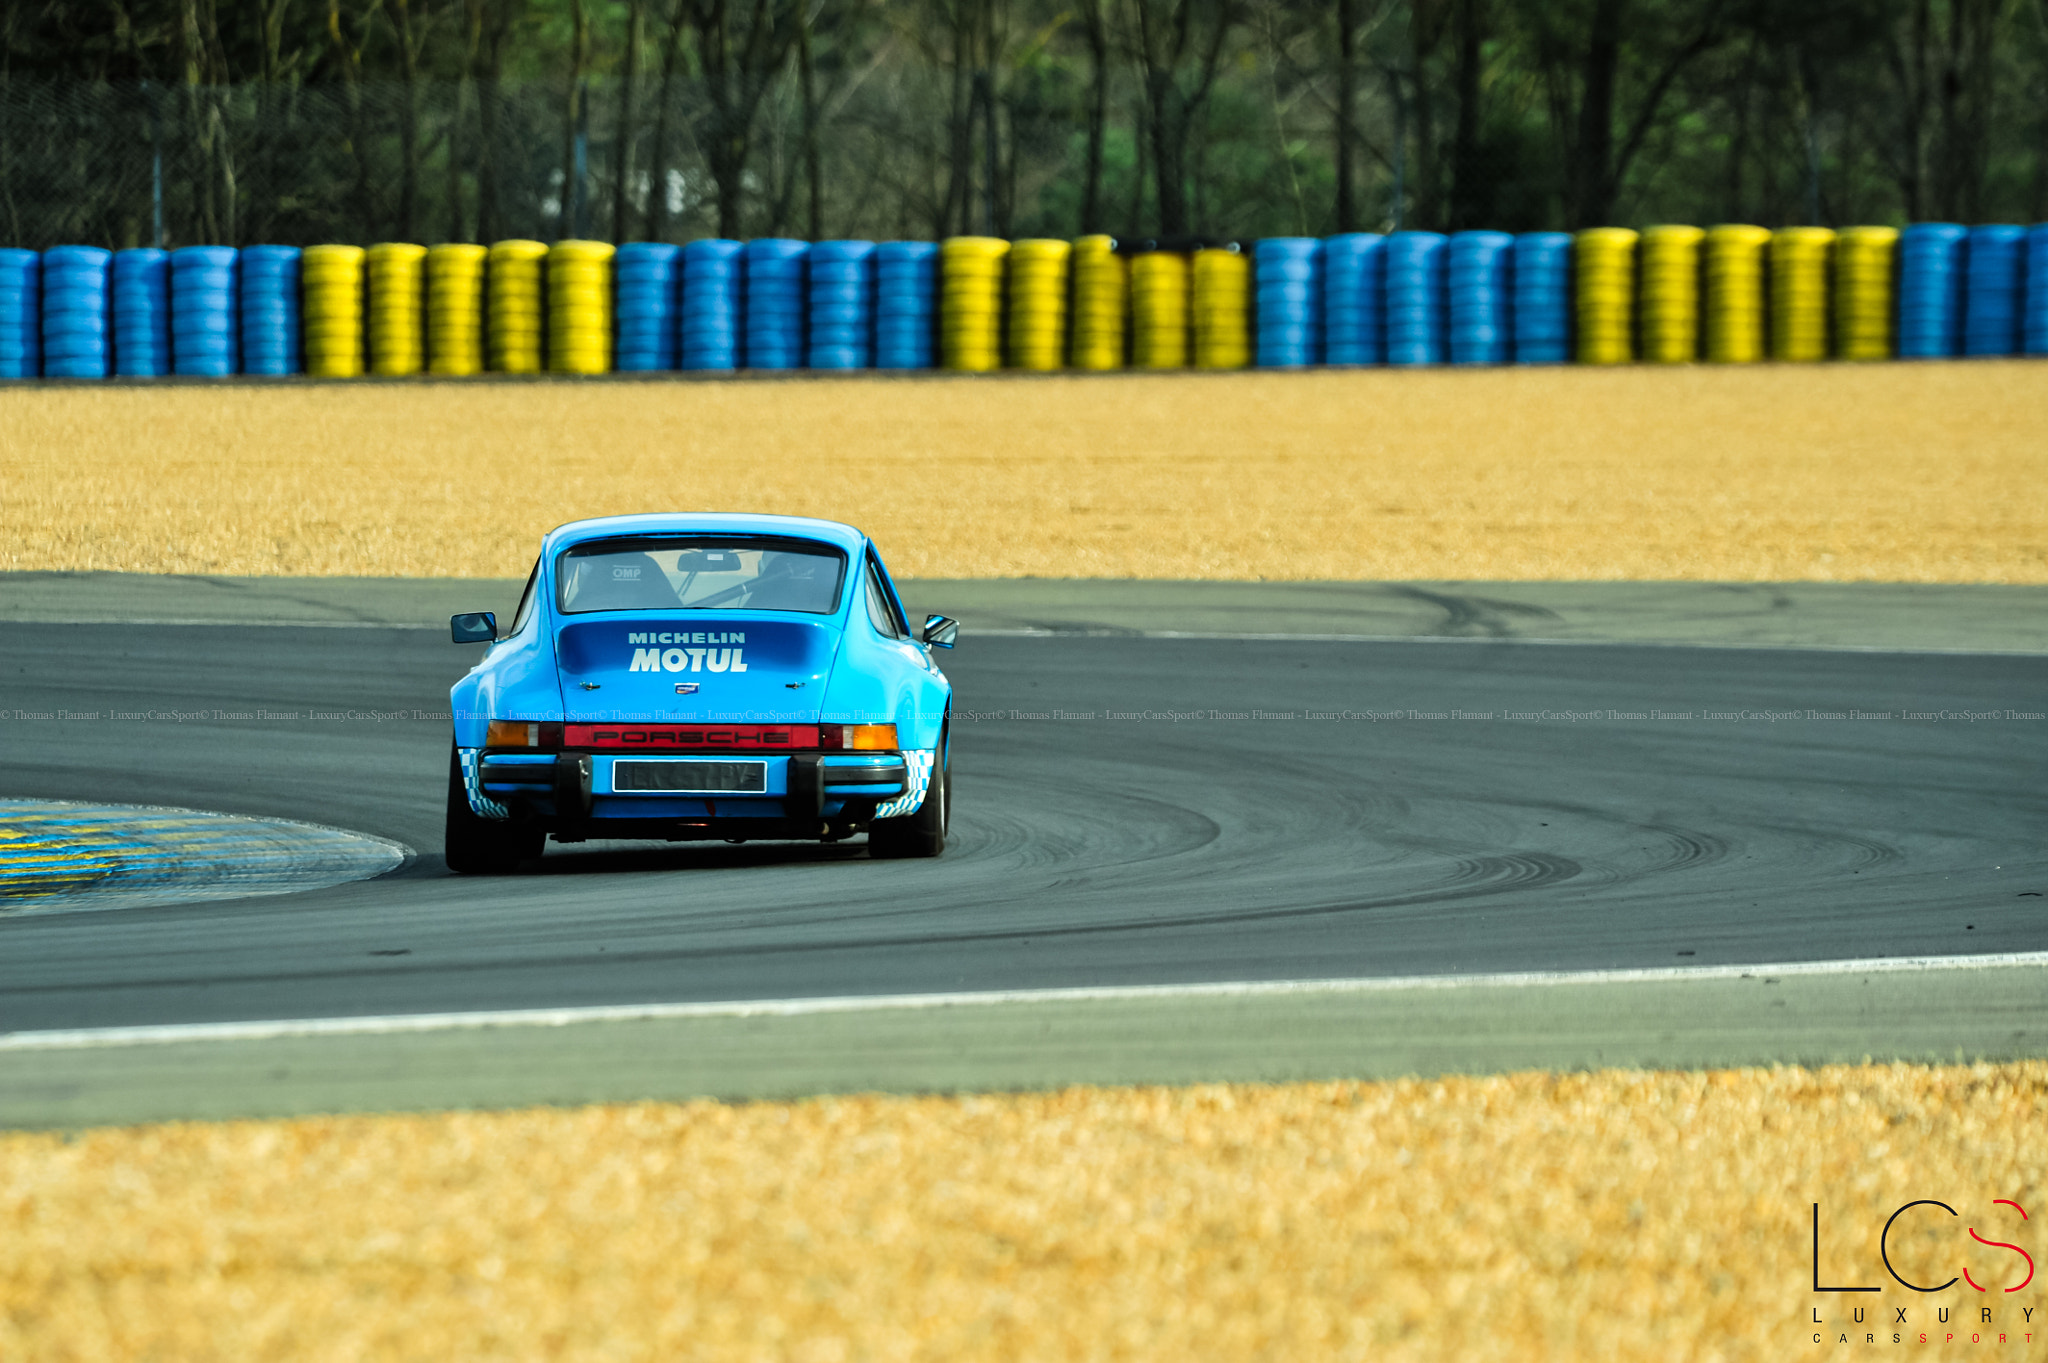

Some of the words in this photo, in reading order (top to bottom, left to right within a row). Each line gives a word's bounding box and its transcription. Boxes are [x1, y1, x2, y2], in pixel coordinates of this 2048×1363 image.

[612, 568, 641, 578] OMP
[628, 632, 746, 644] MICHELIN
[628, 648, 748, 673] MOTUL
[593, 731, 789, 744] PORSCHE
